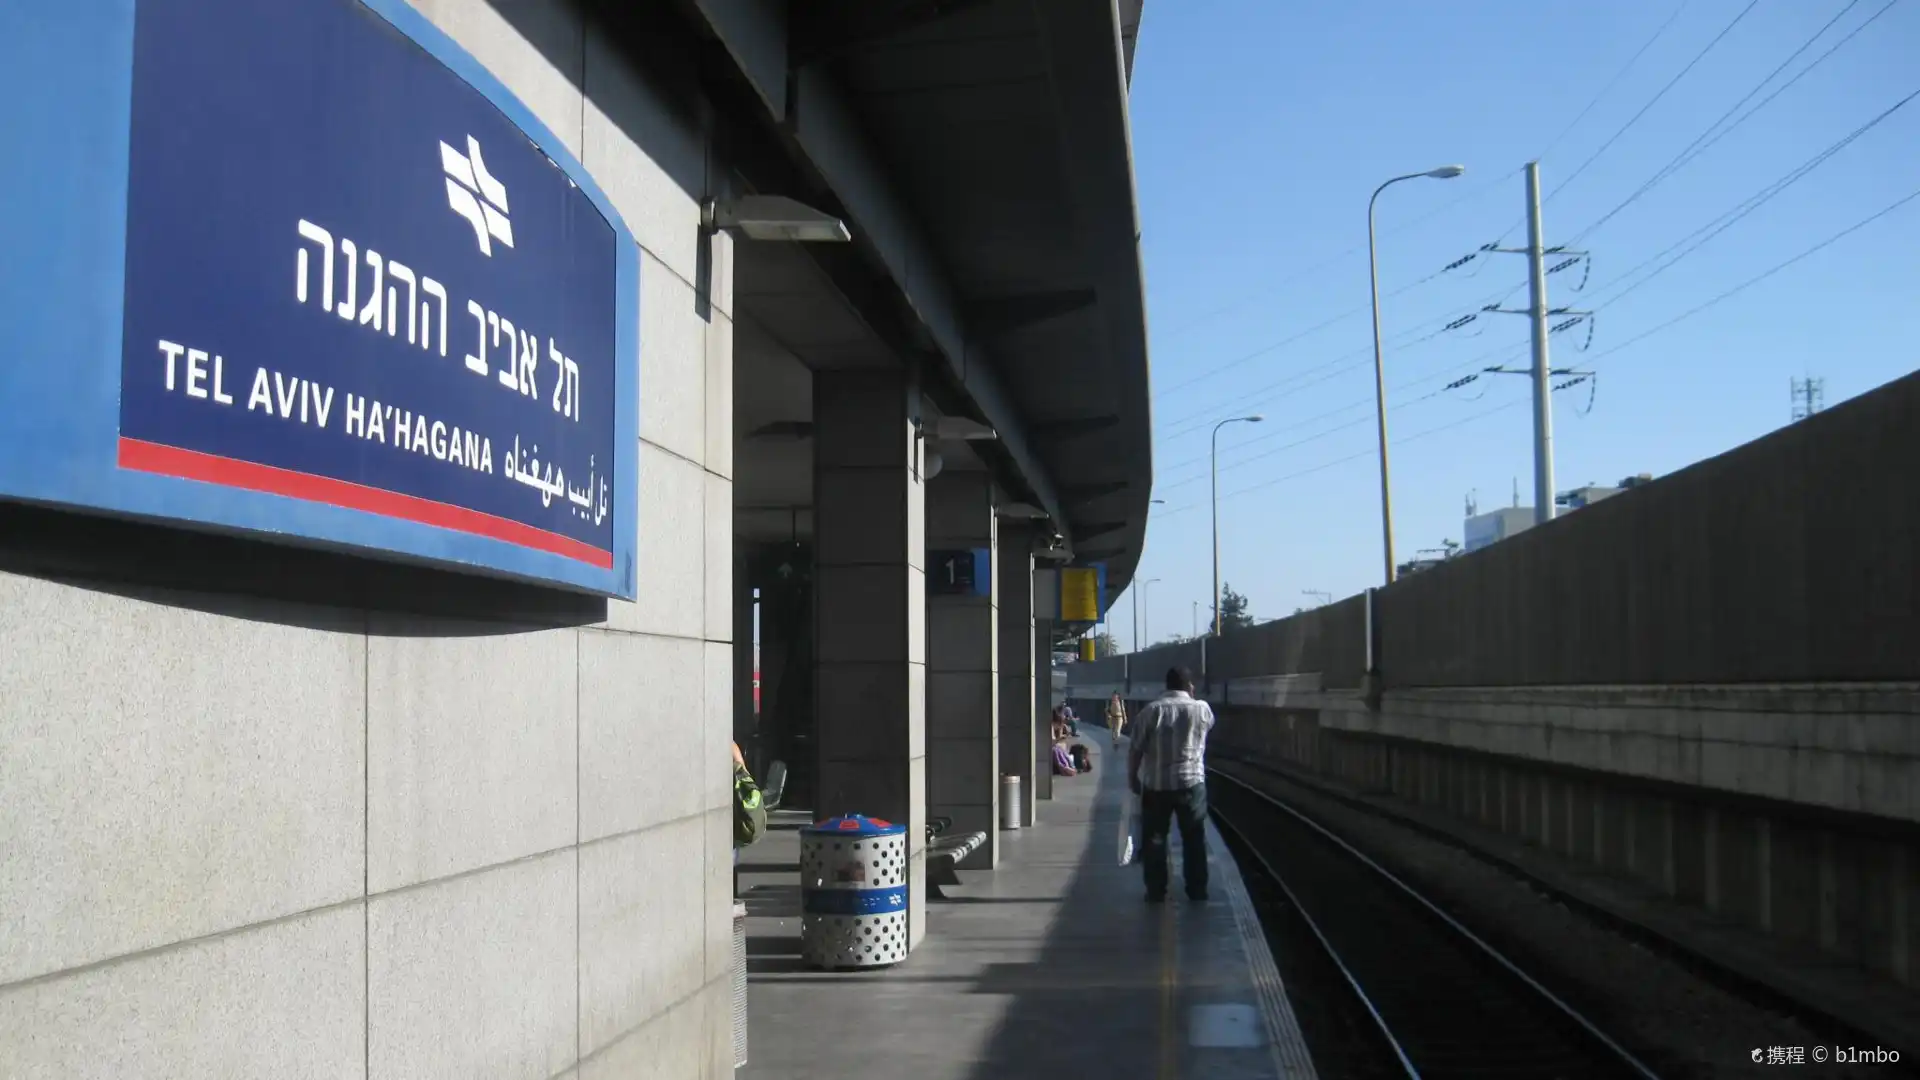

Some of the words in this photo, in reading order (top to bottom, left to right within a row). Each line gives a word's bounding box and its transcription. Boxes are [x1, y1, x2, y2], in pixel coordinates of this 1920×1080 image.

[297, 218, 448, 357] ההגנה
[464, 299, 538, 400] אביב
[548, 337, 579, 422] תל
[158, 339, 233, 405] TEL
[247, 367, 334, 428] AVIV
[346, 393, 493, 475] HA'HAGANA
[945, 558, 955, 585] 1
